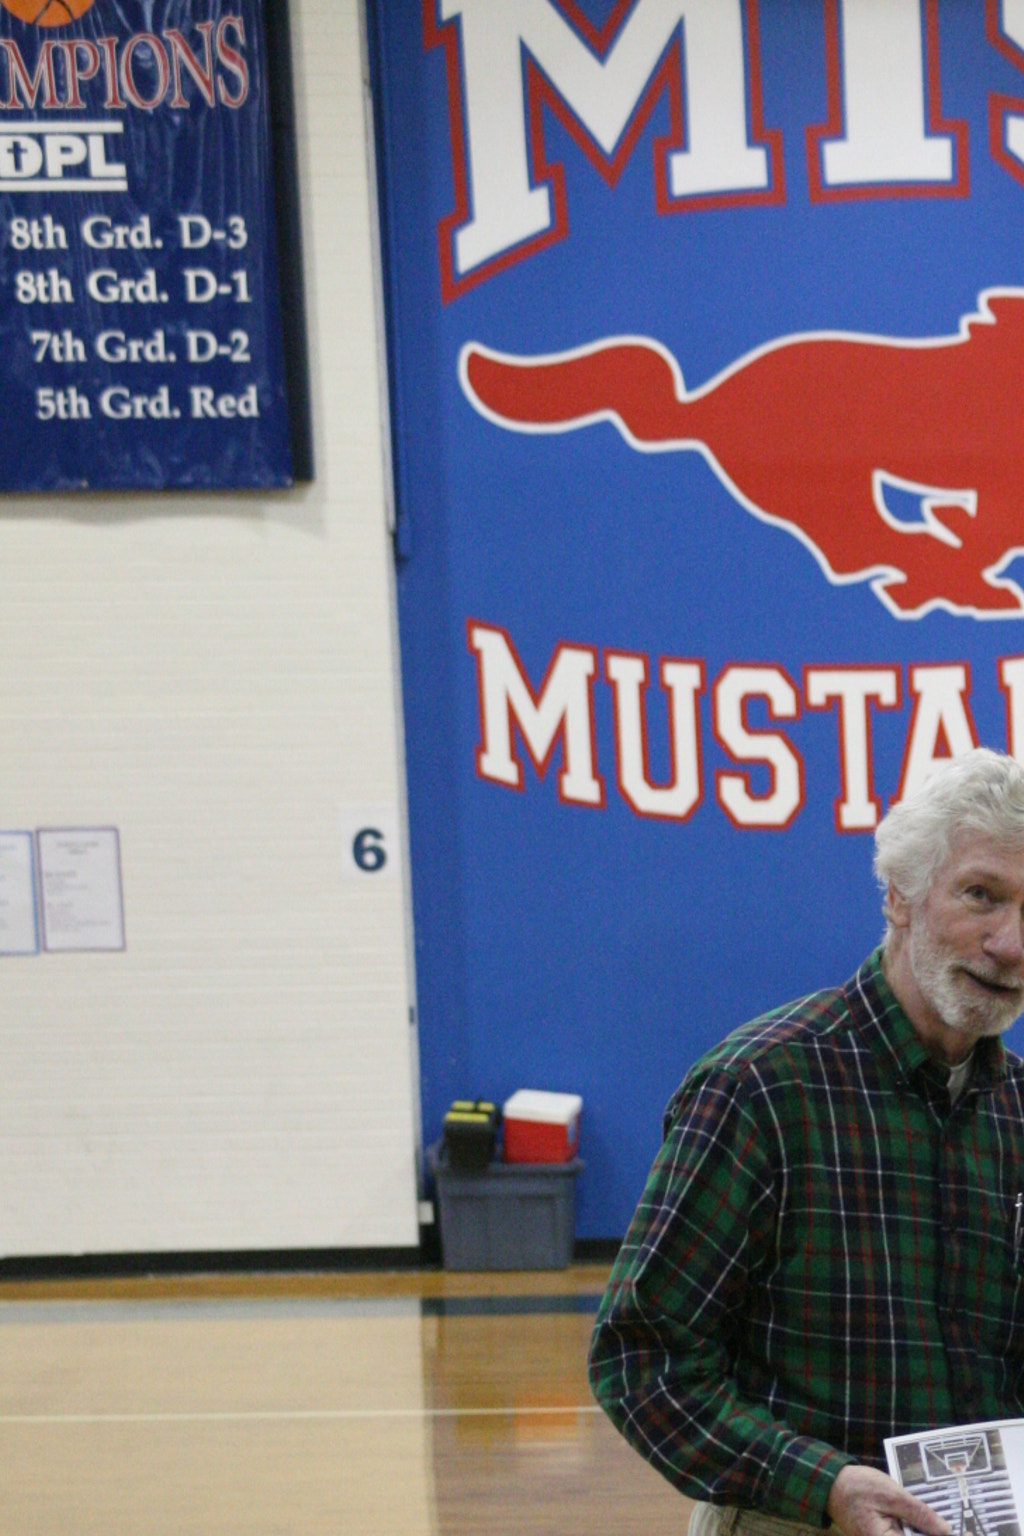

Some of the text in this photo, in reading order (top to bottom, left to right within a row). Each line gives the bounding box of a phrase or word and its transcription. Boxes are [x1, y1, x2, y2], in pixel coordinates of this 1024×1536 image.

[0, 15, 249, 110] MPIONS
[0, 134, 127, 178] DPL
[10, 215, 248, 250] 8th Grd. D-3
[15, 269, 251, 304] 8th Grd. D-1
[32, 330, 250, 363] 7th Grd. D-2
[36, 385, 260, 420] 5th Grd. Red
[352, 826, 387, 873] 6
